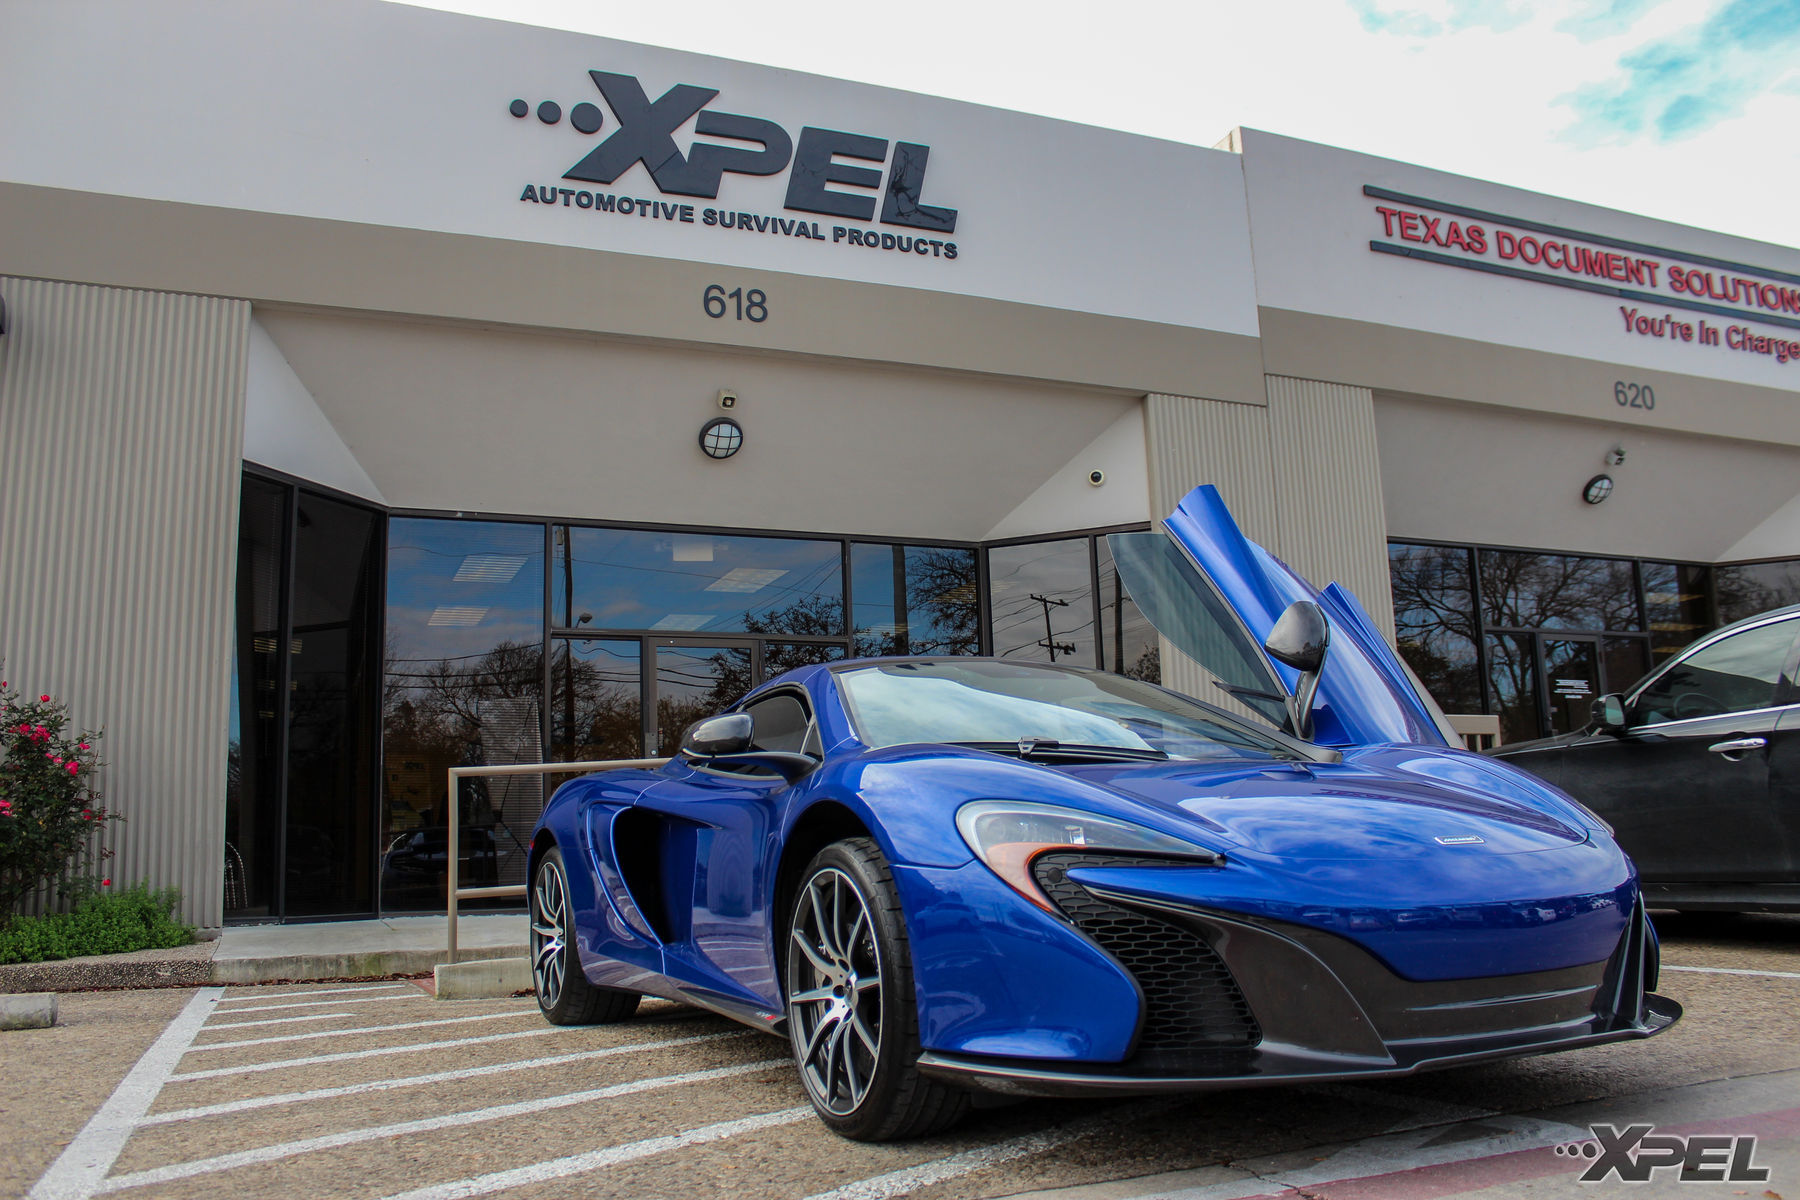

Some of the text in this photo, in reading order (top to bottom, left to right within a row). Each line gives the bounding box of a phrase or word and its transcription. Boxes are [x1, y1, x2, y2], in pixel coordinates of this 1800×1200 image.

[561, 69, 959, 234] XPEL
[520, 183, 958, 259] AUTOMOTIVE SURVIVAL PRODUCTS
[1376, 205, 1800, 316] TEXAS DOCUMENT SOLUTION
[703, 284, 768, 323] 618
[1620, 305, 1800, 364] You're In Charge
[1614, 380, 1656, 411] 620
